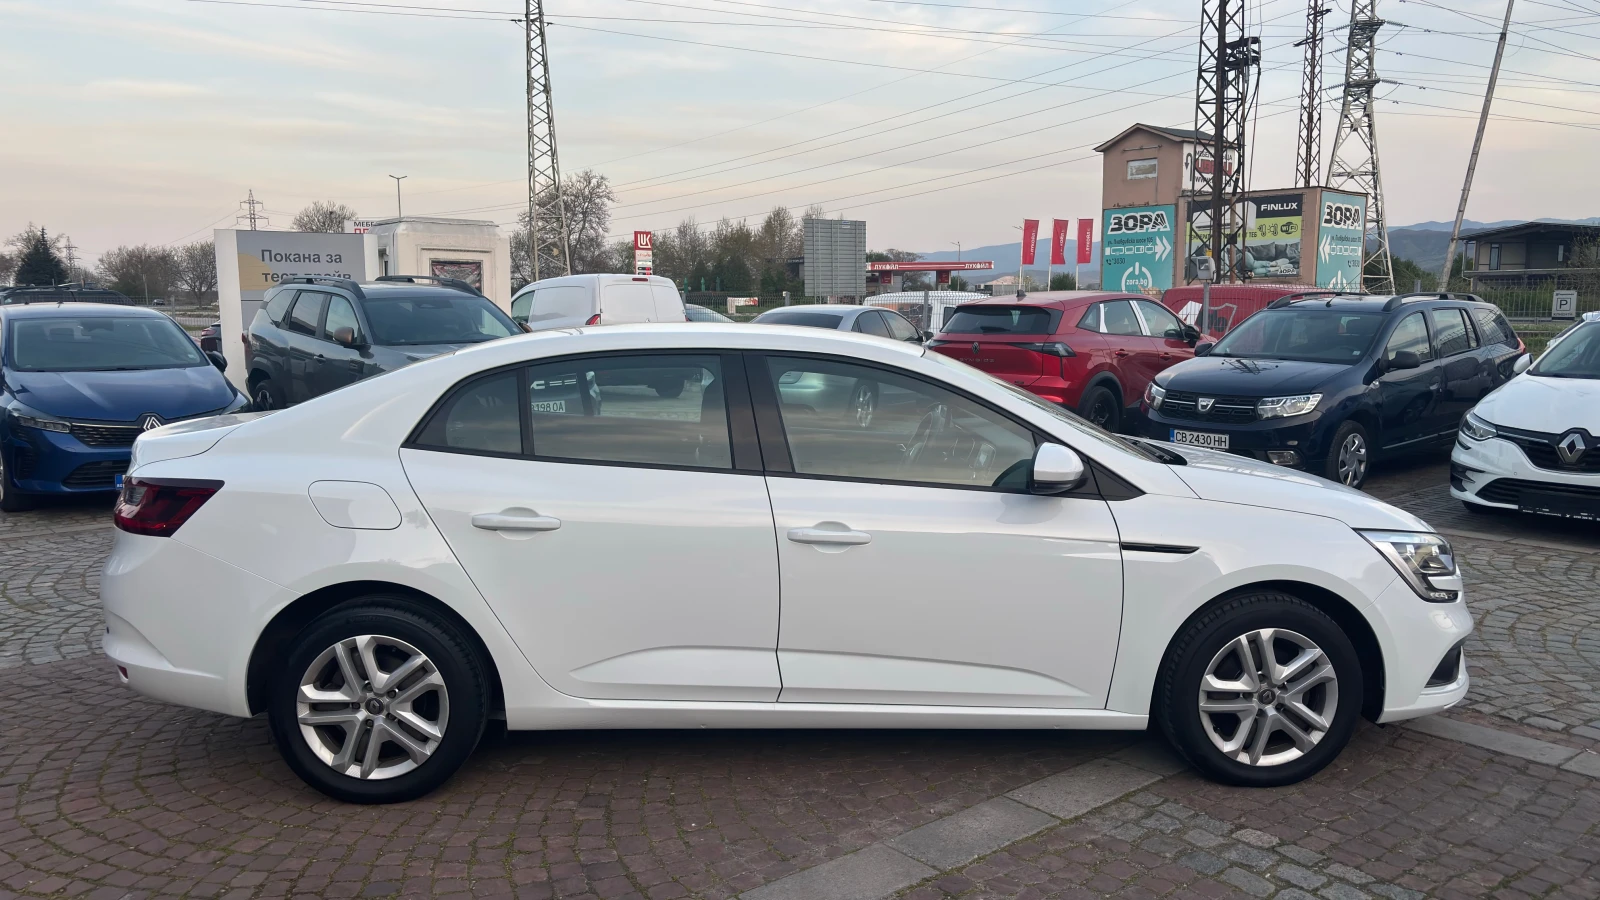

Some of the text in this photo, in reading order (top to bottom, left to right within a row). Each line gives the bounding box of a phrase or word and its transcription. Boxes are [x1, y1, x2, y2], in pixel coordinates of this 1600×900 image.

[1261, 203, 1298, 211] FINLUX
[1322, 202, 1362, 230] ЗОРА
[1108, 211, 1170, 234] ЗОРА
[261, 249, 342, 264] Покана за
[1126, 278, 1148, 287] zora.bg
[1560, 300, 1568, 309] P
[1188, 433, 1212, 445] 2430
